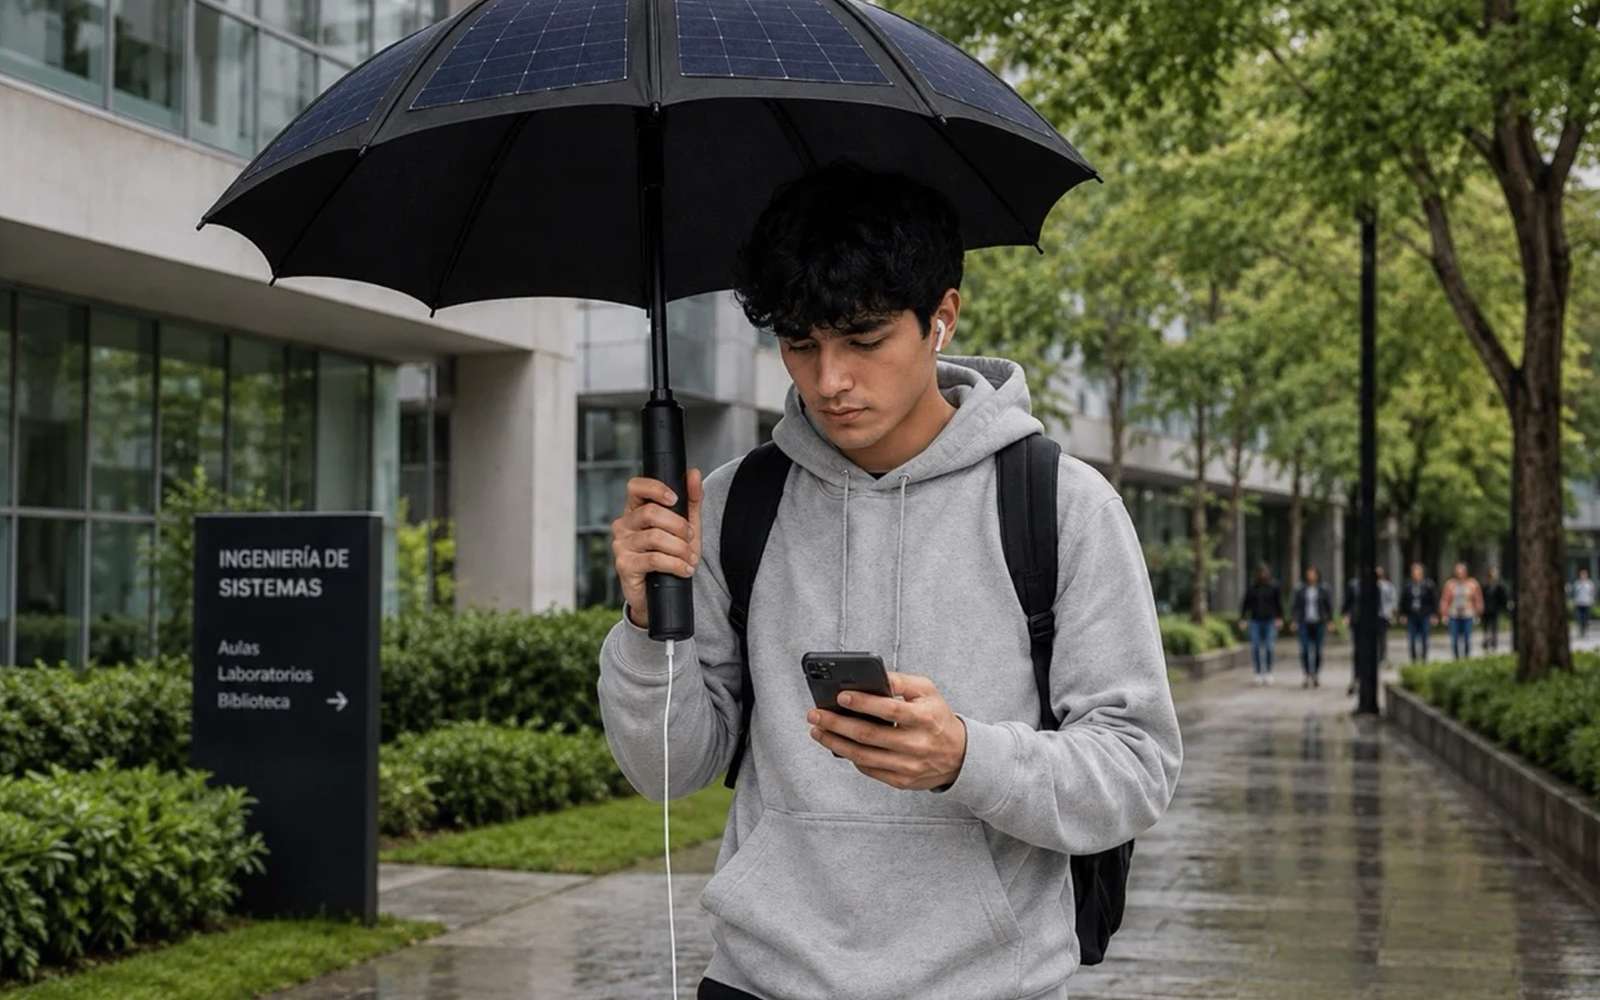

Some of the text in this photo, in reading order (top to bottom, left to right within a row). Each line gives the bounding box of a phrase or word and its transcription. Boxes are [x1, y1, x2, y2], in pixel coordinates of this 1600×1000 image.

[219, 545, 349, 568] INGENIERÍA DE
[218, 578, 323, 597] SISTEMAS
[218, 640, 260, 656] Aulas
[218, 665, 313, 683] Laboratorios
[218, 692, 291, 710] Biblioteca
